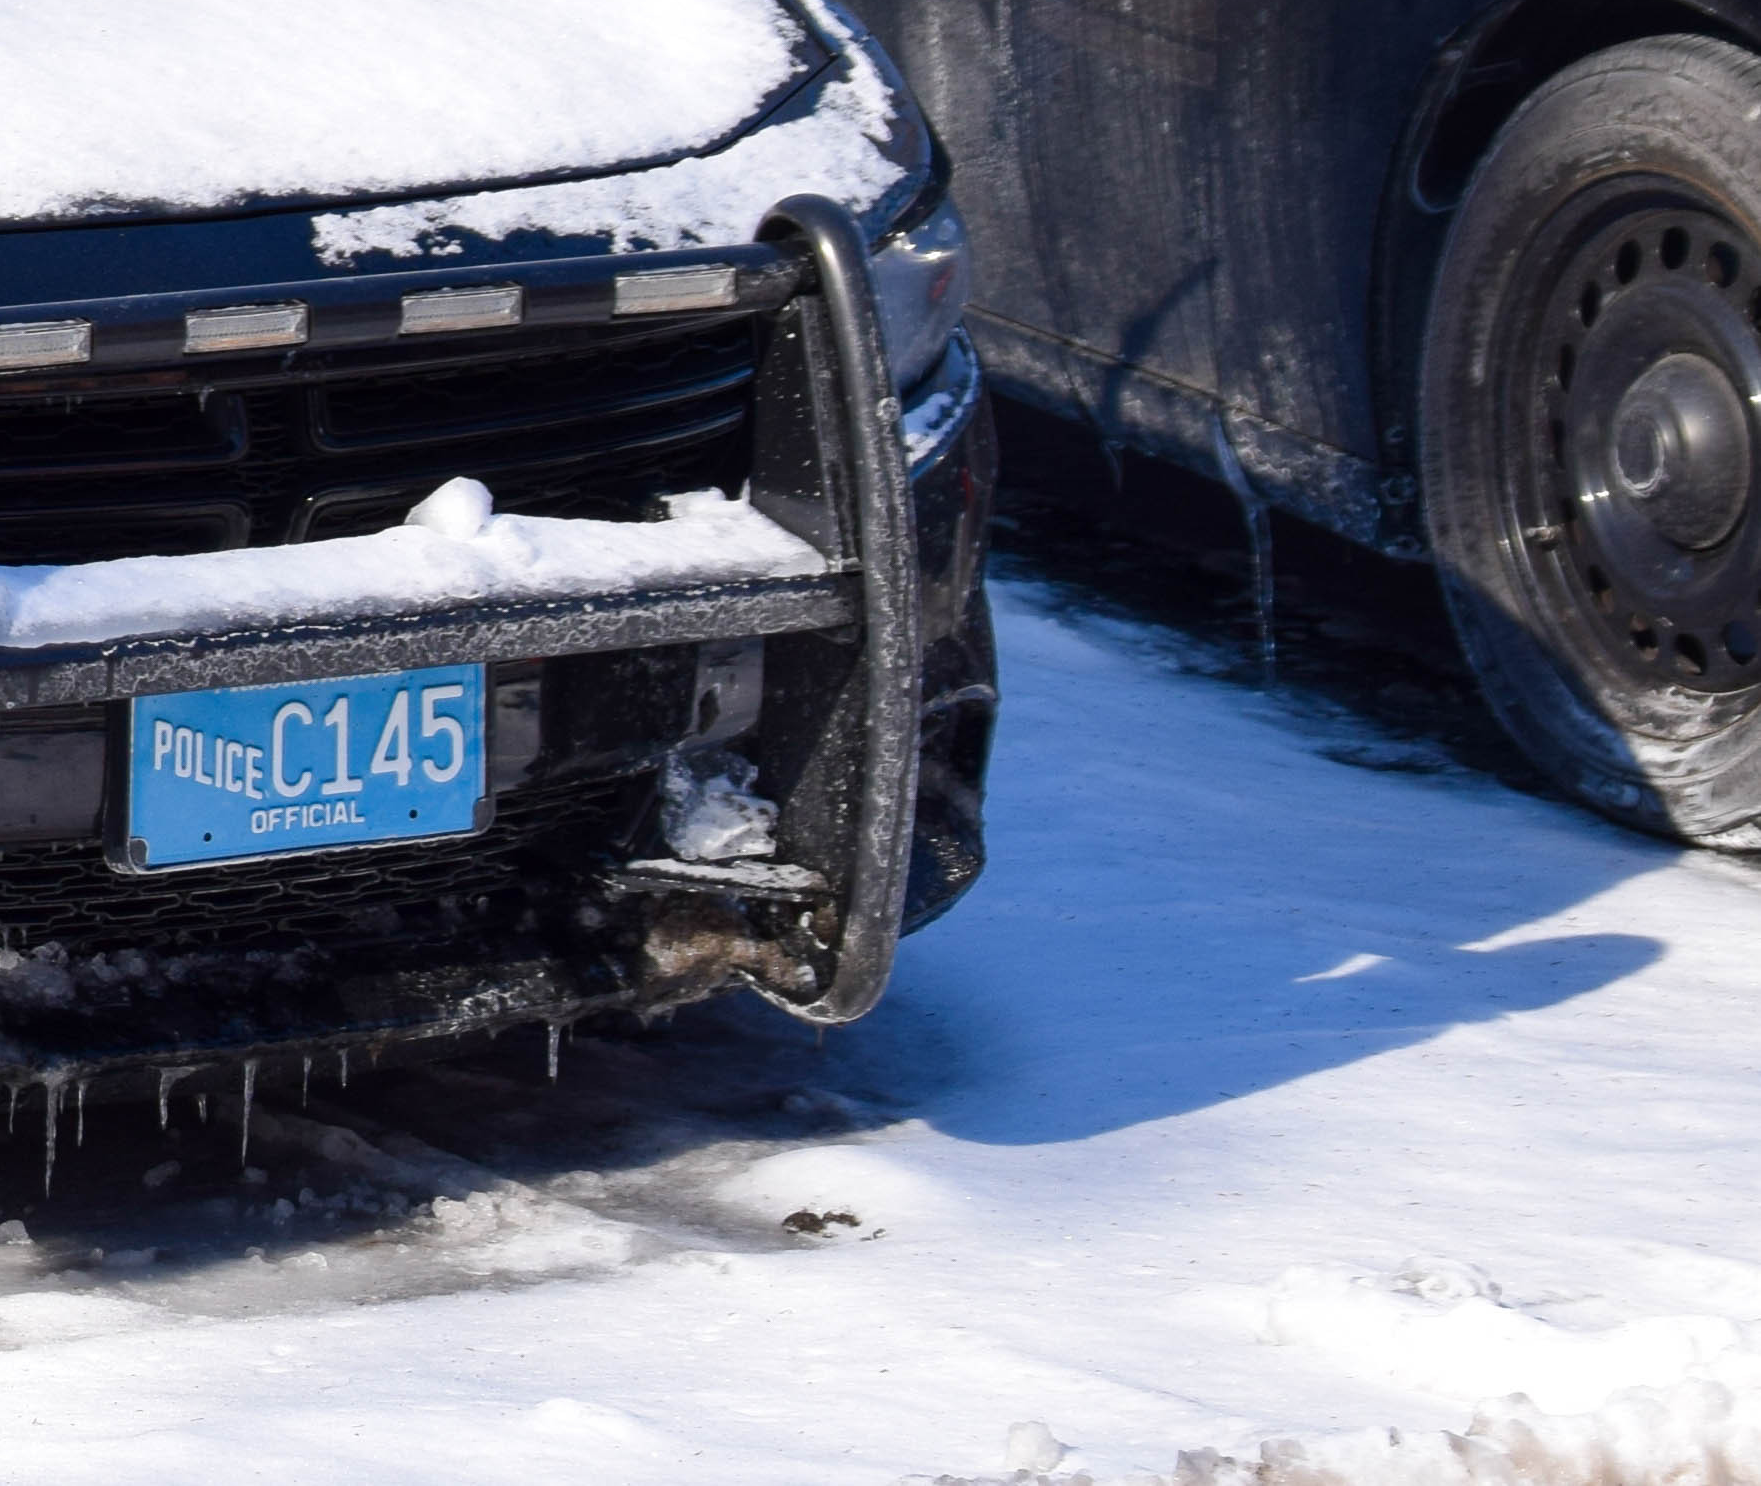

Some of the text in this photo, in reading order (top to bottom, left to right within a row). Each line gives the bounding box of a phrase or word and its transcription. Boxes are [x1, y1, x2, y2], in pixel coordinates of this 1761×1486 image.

[153, 684, 465, 800] POLICE C145
[250, 800, 366, 834] OFFICIAL
